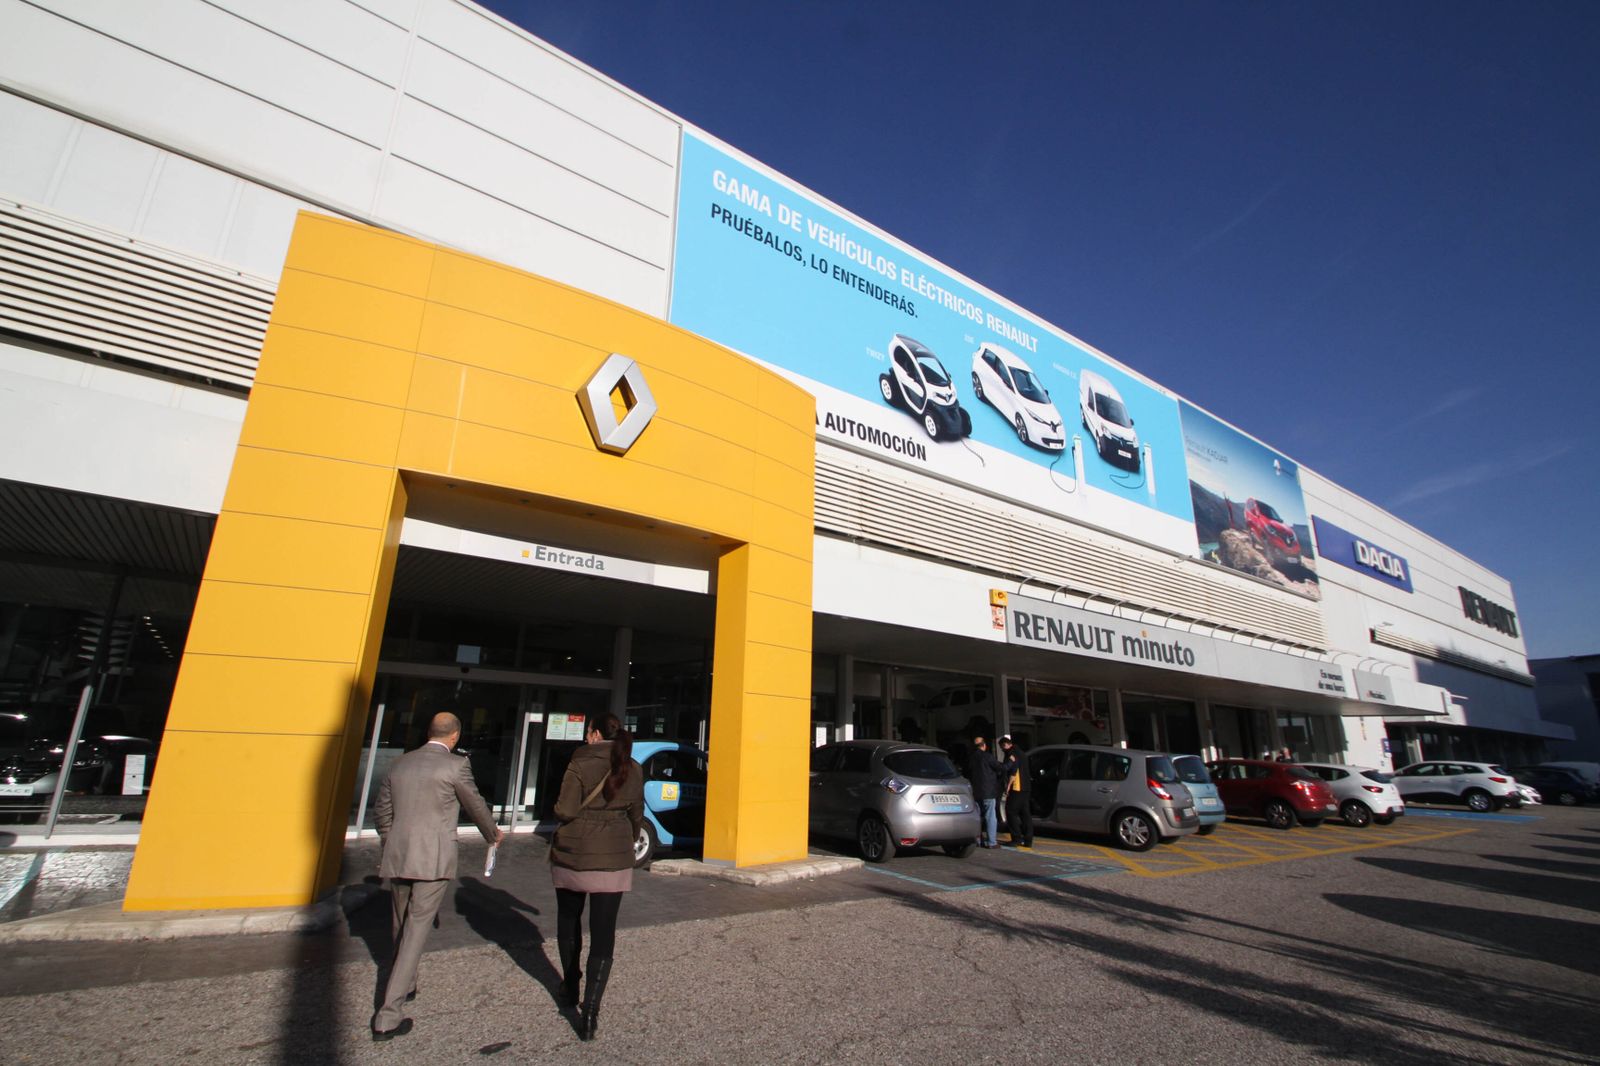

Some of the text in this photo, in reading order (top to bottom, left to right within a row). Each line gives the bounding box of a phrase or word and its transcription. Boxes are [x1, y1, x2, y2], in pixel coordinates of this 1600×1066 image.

[711, 203, 919, 319] PRUÉBALOS, LO ENTENDERÁS.
[712, 169, 1039, 353] GAMA DE VEHÍCULOS ELÉCTRICOS RENAULT
[825, 412, 927, 461] AUTOMOCIÓN
[535, 545, 605, 571] Entrada
[1354, 540, 1406, 581] DACIA
[1013, 610, 1115, 654] RENAULT
[1122, 630, 1195, 667] minuto
